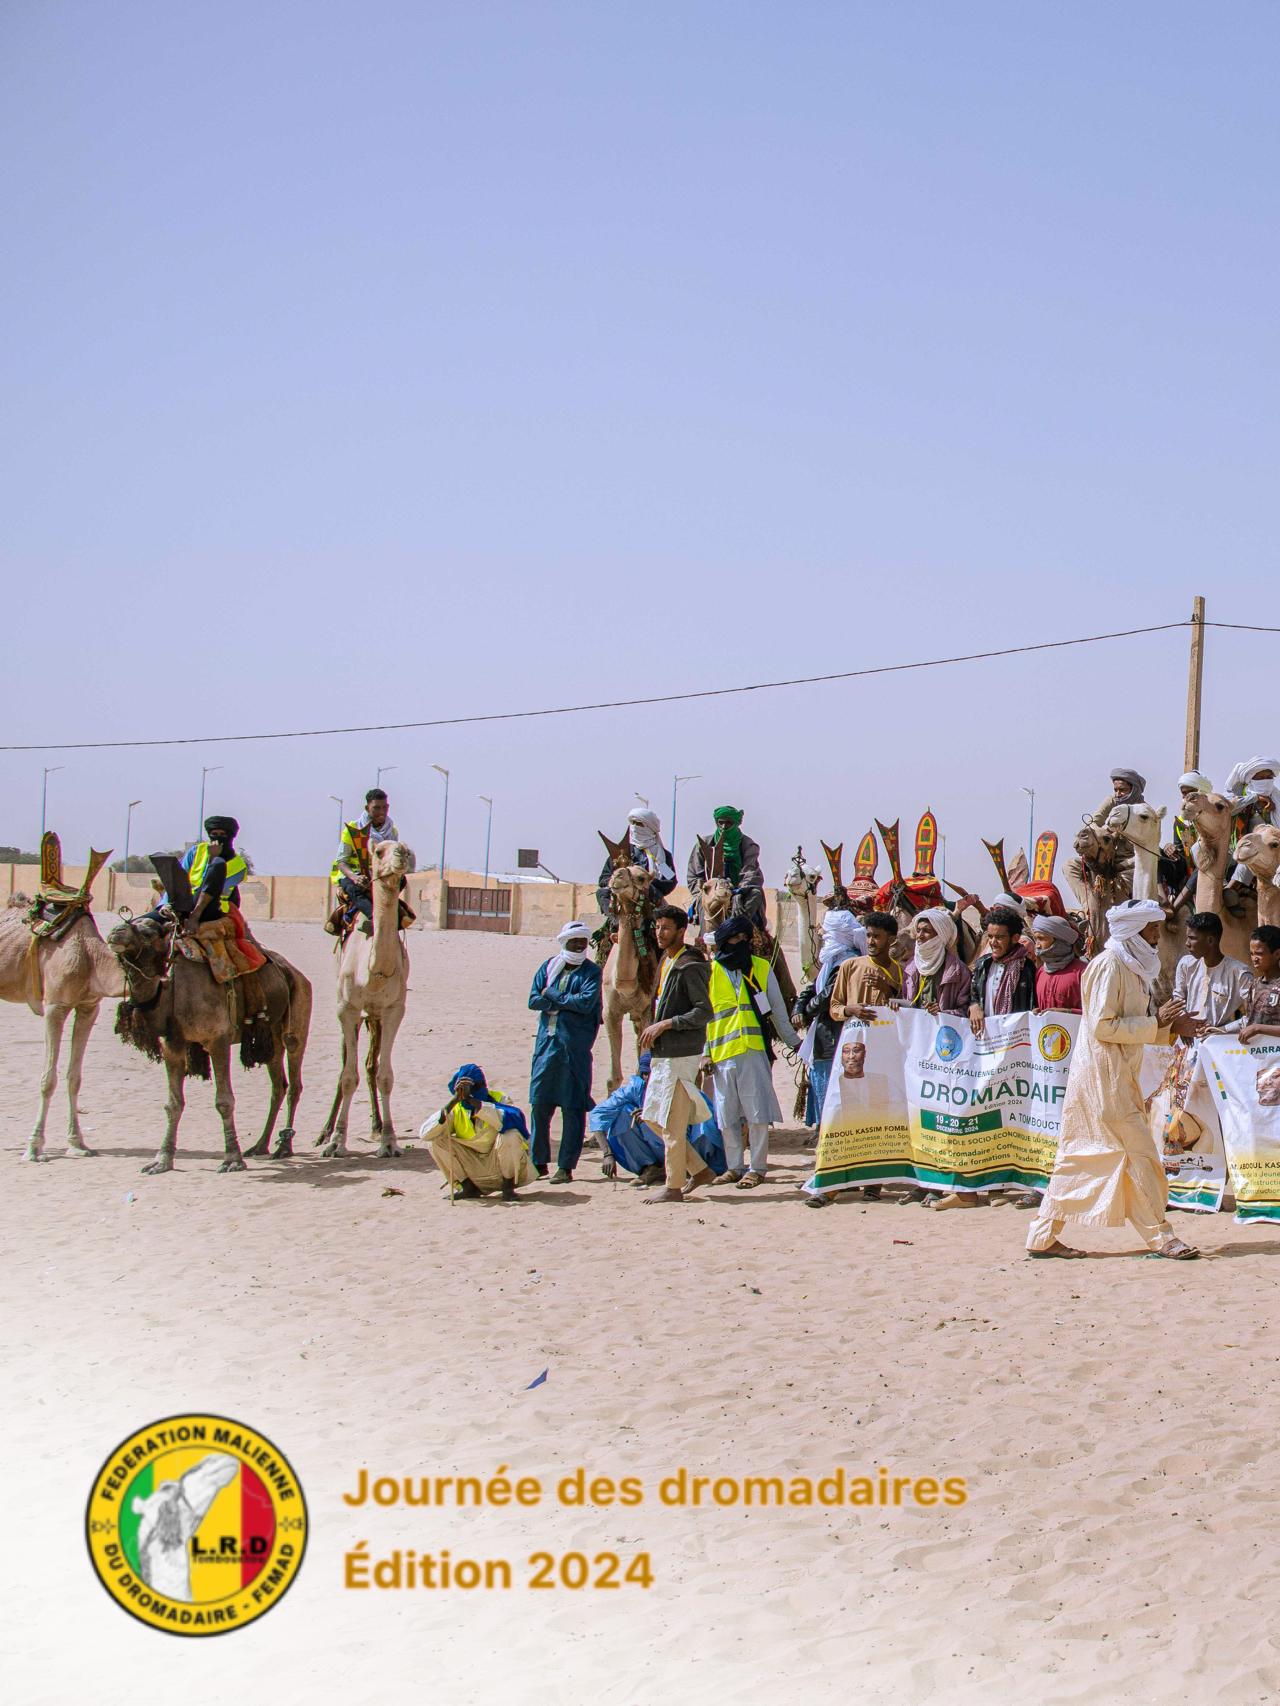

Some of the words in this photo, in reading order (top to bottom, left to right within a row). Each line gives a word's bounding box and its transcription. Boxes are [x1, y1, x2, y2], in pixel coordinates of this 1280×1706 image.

[957, 1068, 995, 1077] MALIENNE
[997, 1066, 1008, 1074] DU
[1010, 1061, 1053, 1073] DROMADAIRE
[935, 1115, 944, 1124] 19
[950, 1118, 959, 1127] 20
[968, 1116, 979, 1126] 21
[1009, 1113, 1016, 1121] A
[825, 1130, 854, 1139] ABDOUL
[855, 1126, 882, 1134] KASSIM
[852, 1135, 883, 1144] Jeunesse,
[832, 1151, 872, 1161] Construction
[971, 1153, 1010, 1165] formations
[1239, 1161, 1262, 1170] ABDOUL
